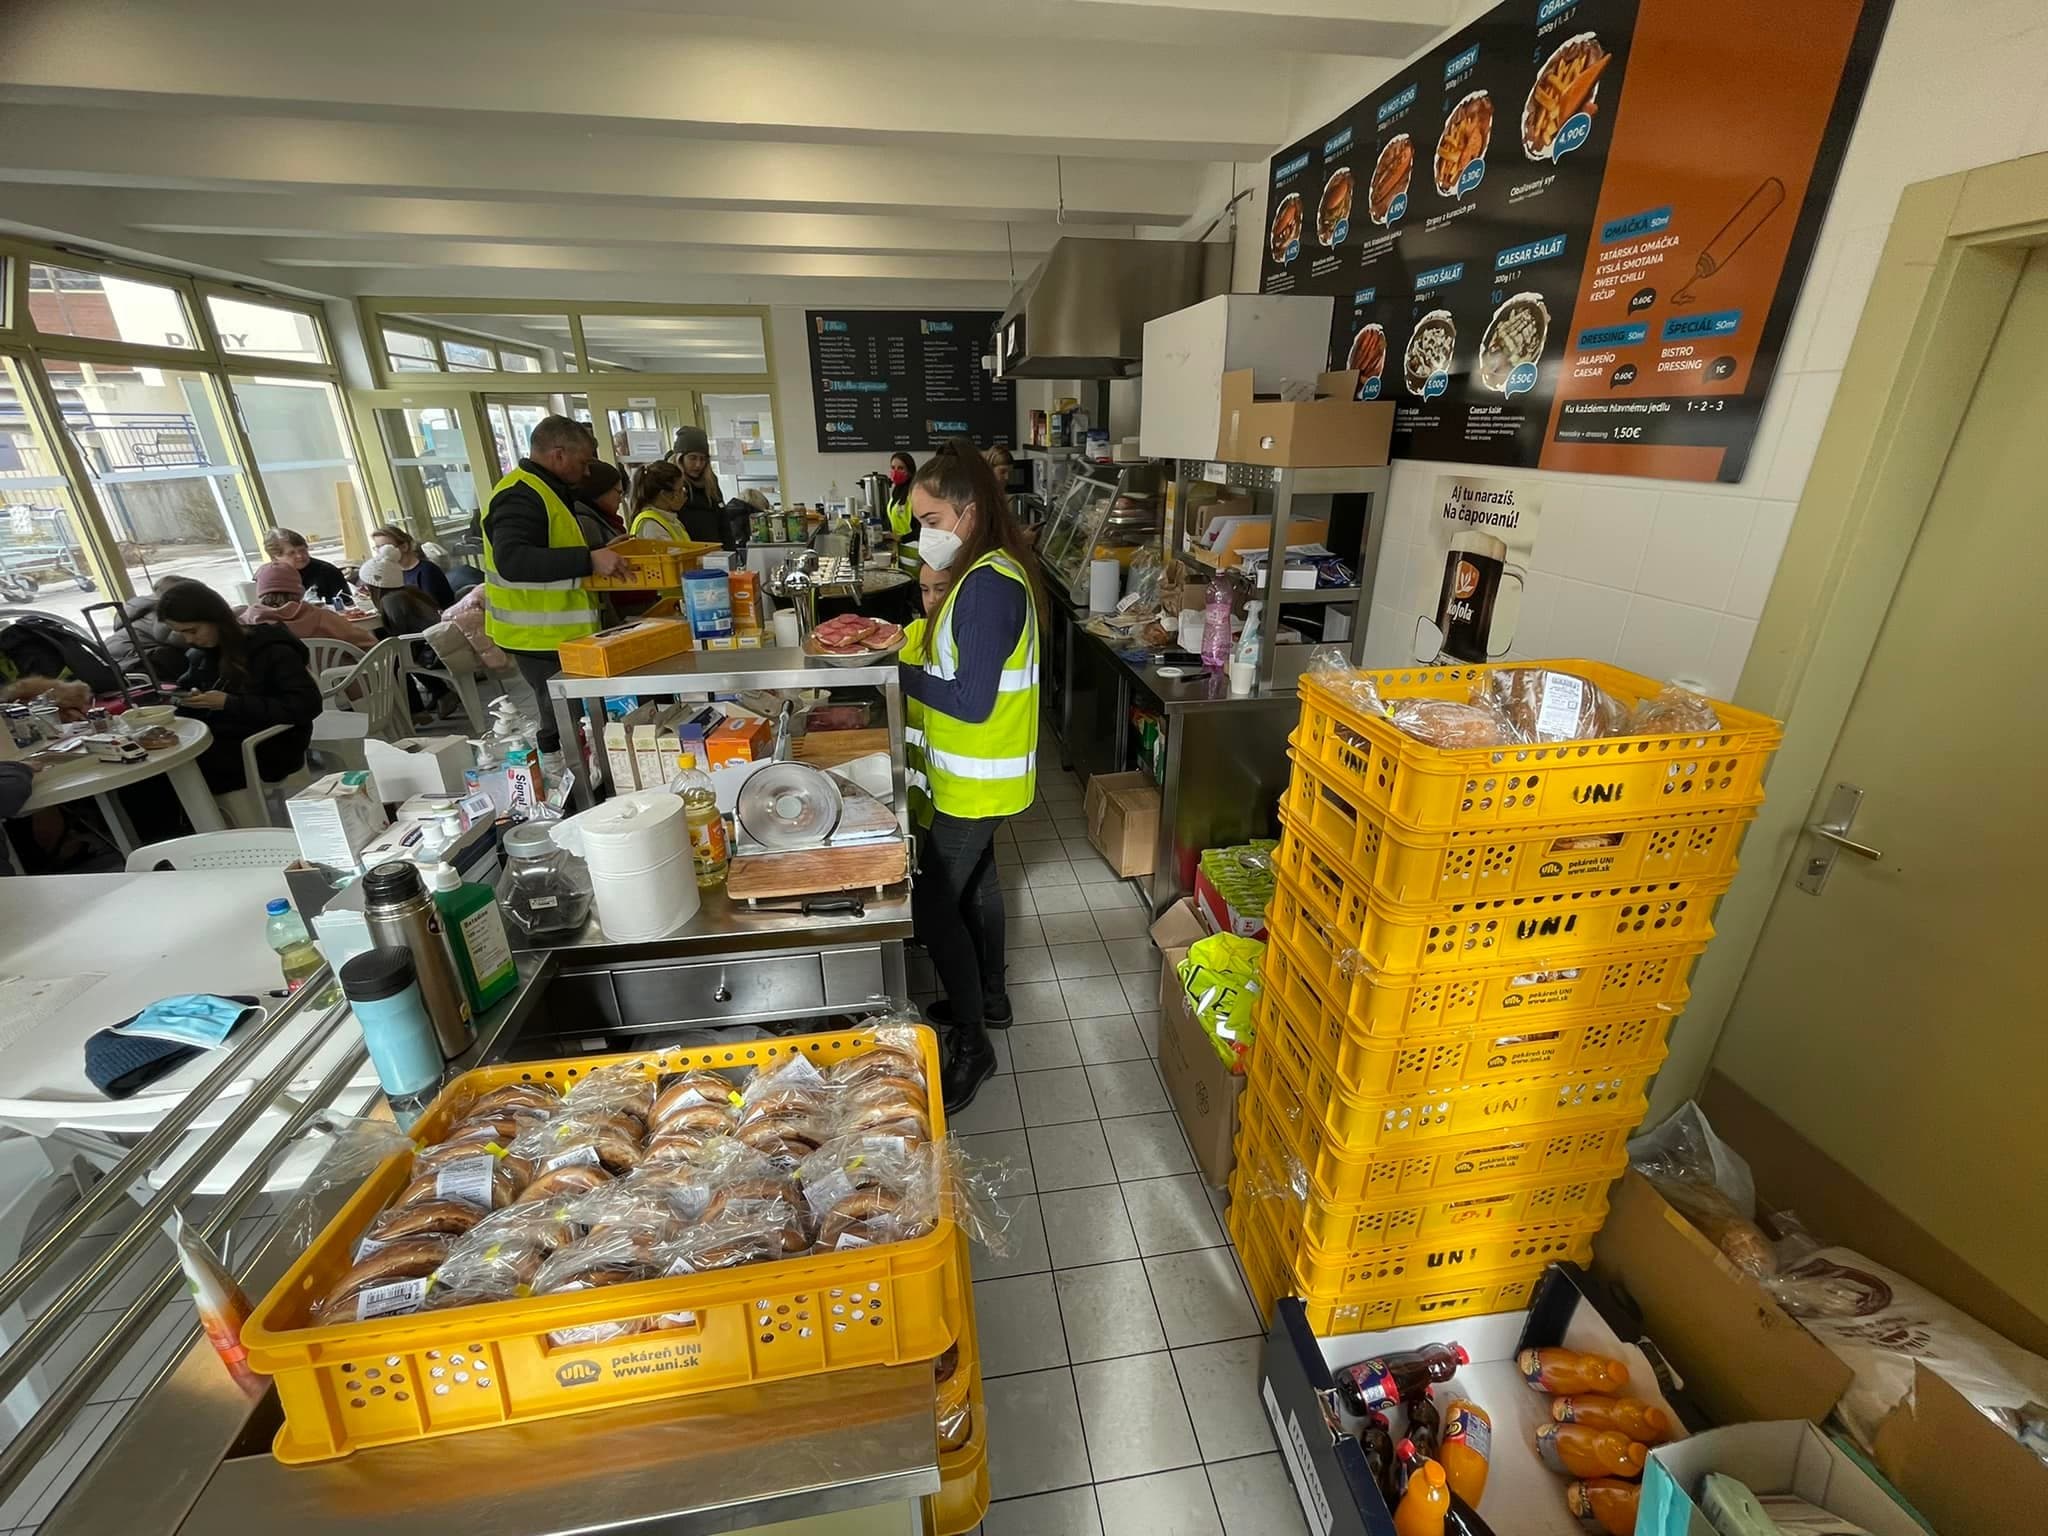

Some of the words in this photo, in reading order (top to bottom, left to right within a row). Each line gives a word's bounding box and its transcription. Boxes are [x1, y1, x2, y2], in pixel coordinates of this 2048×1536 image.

[1447, 50, 1477, 76] STRIPSY
[1604, 216, 1649, 238] OMÁČKA
[1650, 215, 1670, 228] 50ml
[1497, 249, 1532, 268] CAESAR
[1532, 240, 1564, 258] ŠALÁT
[1599, 246, 1639, 262] TATÁRSKA
[1640, 235, 1680, 254] OMÁČKA
[1596, 261, 1623, 276] KYSLÁ
[1622, 253, 1664, 272] SMOTANA
[1416, 274, 1439, 288] BISTRO
[1592, 276, 1619, 289] SWEET
[1619, 271, 1646, 285] CHILLI
[1590, 288, 1616, 302] KEČUP
[1667, 319, 1714, 335] ŠPECIÁL
[1715, 319, 1737, 331] 50ml
[1580, 330, 1625, 346] DRESSING
[1627, 330, 1646, 341] 50ml
[1661, 345, 1694, 359] BISTRO
[1573, 367, 1603, 378] CAESAR
[1657, 359, 1703, 373] DRESSING
[1508, 372, 1534, 386] 5,50€
[1469, 406, 1488, 415] Caesar
[1565, 404, 1575, 414] Ku
[1575, 403, 1609, 414] každému
[1609, 402, 1648, 413] hlavnému
[1648, 402, 1671, 414] jedlu
[1613, 427, 1642, 439] 1,50€
[1451, 485, 1463, 500] Aj
[1463, 487, 1475, 501] tu
[1475, 489, 1515, 506] narazíš.
[1443, 503, 1457, 519] Na
[1458, 505, 1520, 529] čapovanú!
[1447, 598, 1474, 621] kofola
[515, 773, 528, 807] Signal
[1573, 783, 1624, 804] UNI
[1567, 865, 1611, 876] www.uni.sk
[1599, 856, 1615, 866] UNI
[1516, 913, 1578, 940] UNI
[1427, 1248, 1477, 1268] UNI
[611, 1347, 673, 1368] pekáreň
[675, 1343, 702, 1356] UNI
[613, 1356, 700, 1379] www.uni.sk
